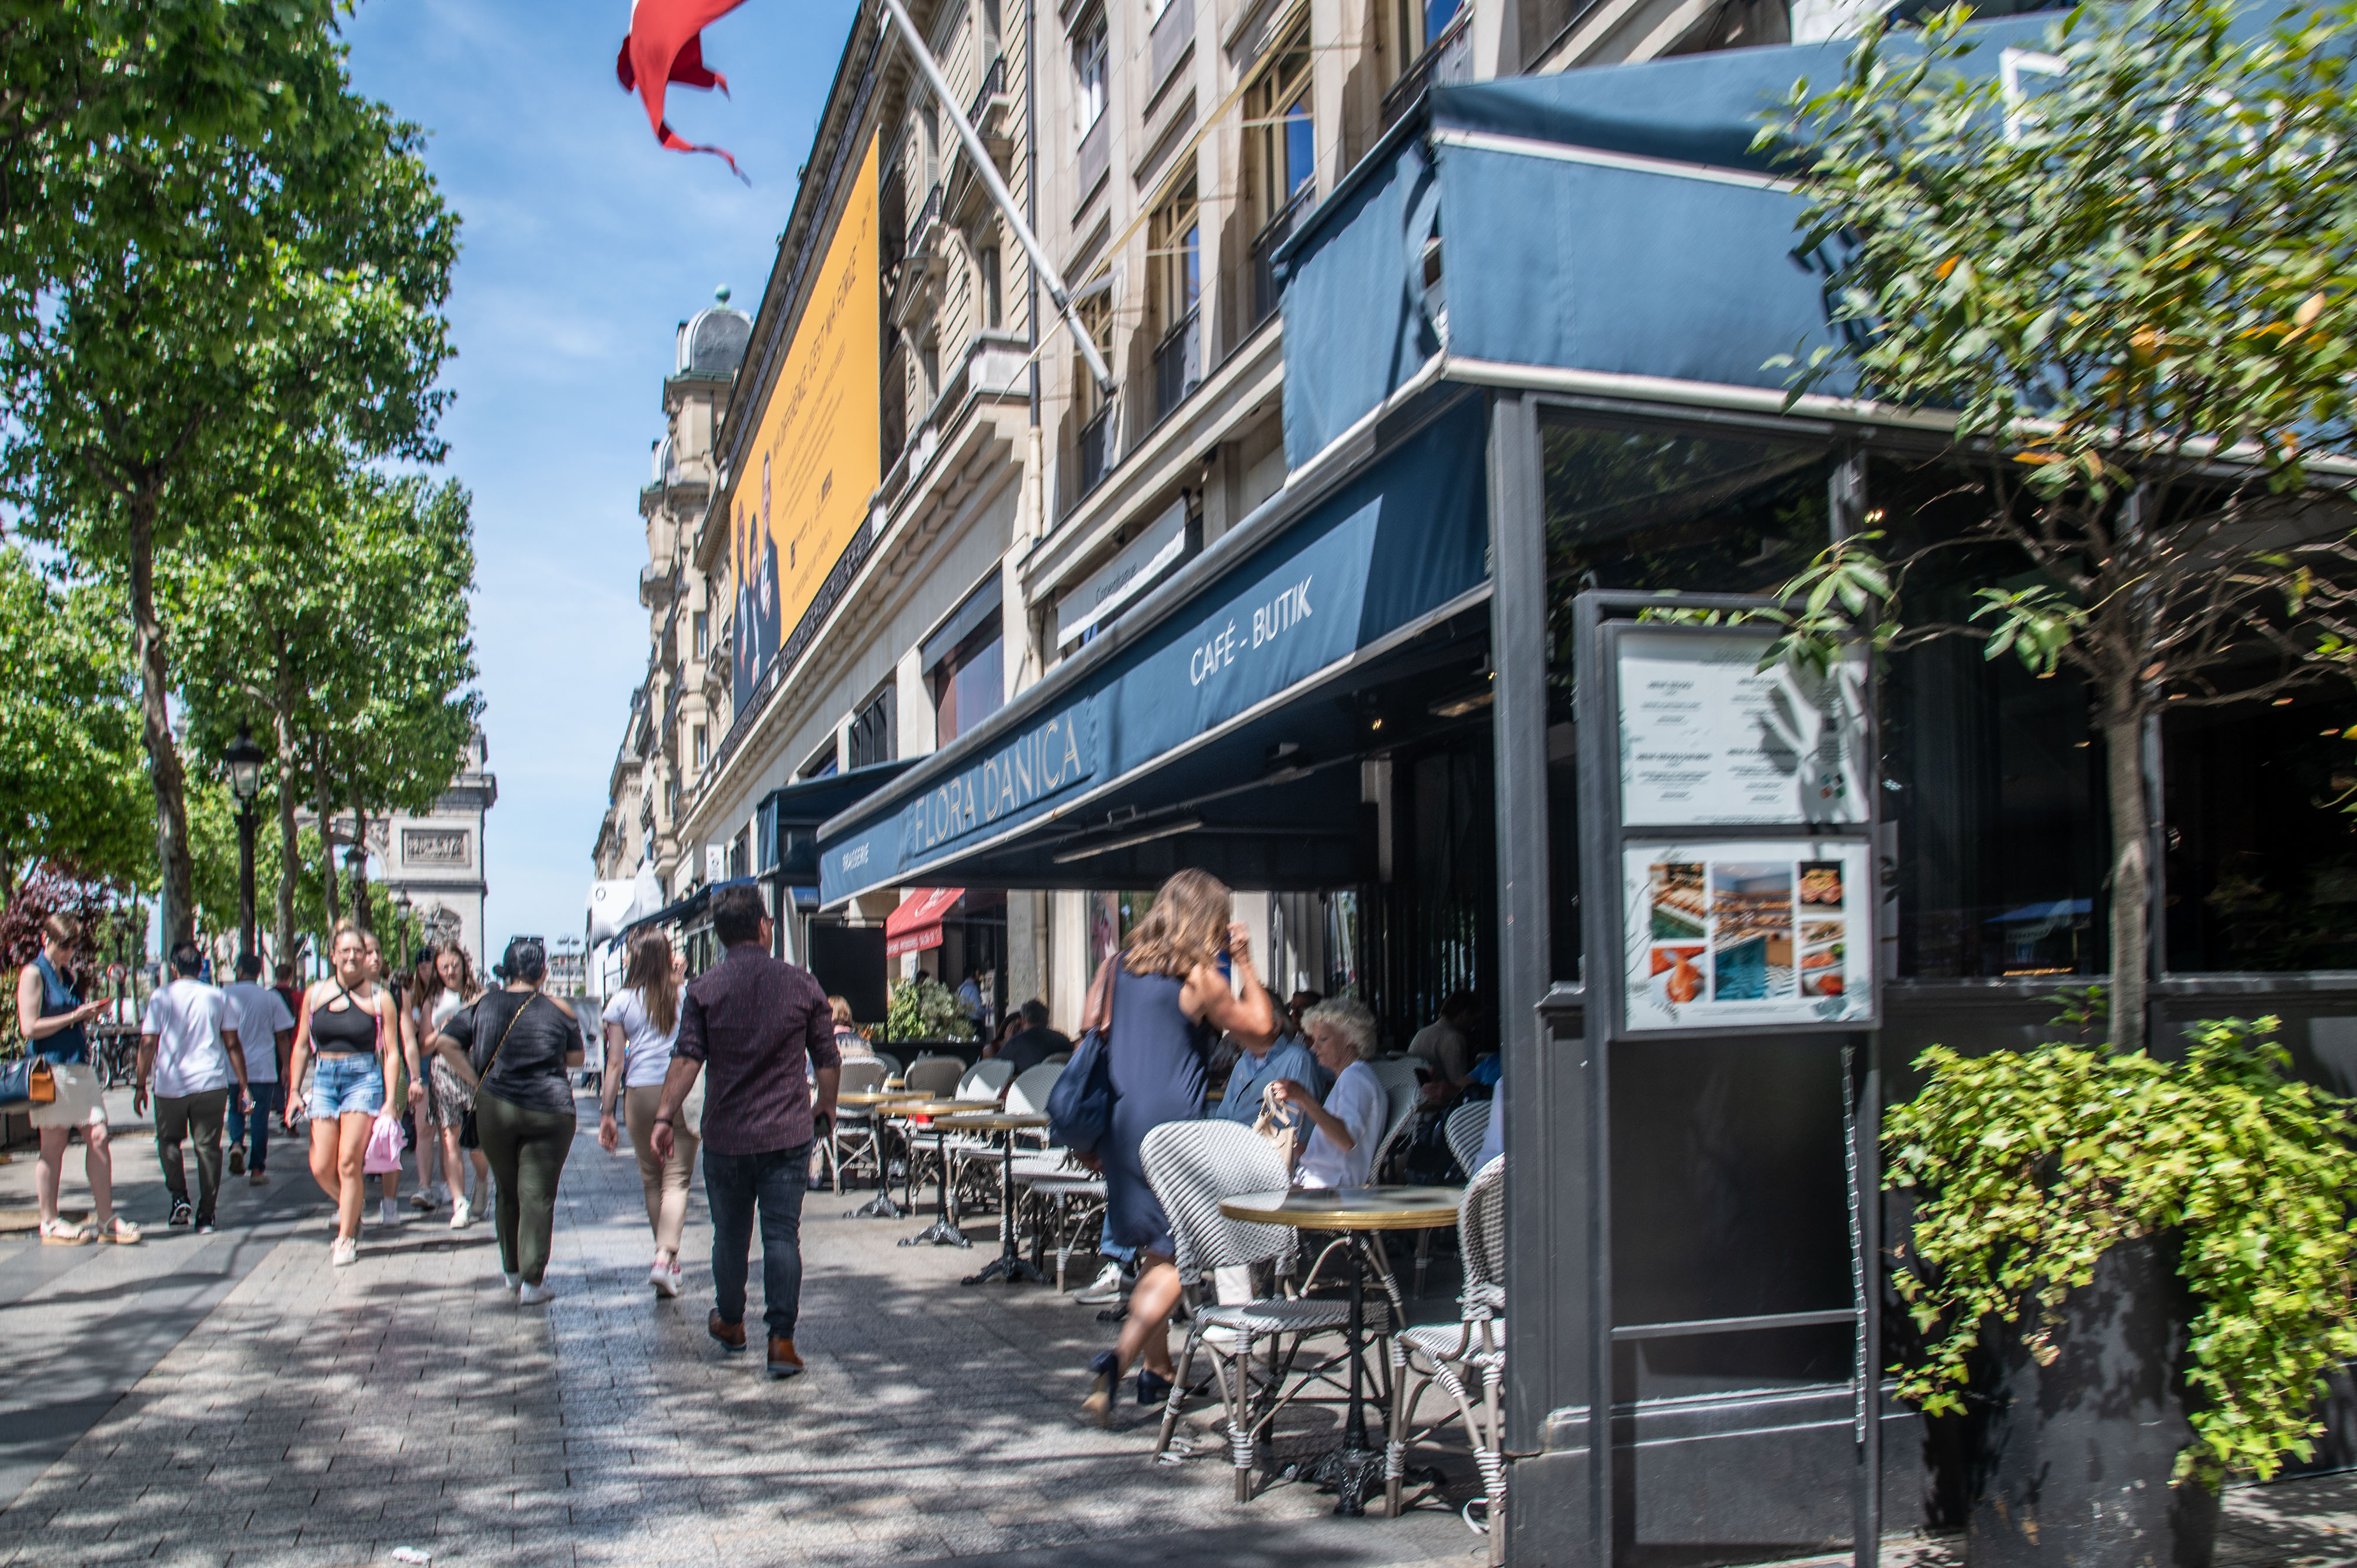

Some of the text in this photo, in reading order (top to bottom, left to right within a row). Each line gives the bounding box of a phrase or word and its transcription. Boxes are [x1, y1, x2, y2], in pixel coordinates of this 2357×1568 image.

[1190, 617, 1237, 687] CAFÉ
[1252, 573, 1314, 650] BUTIK
[915, 709, 1081, 852] FLORA DANICA
[842, 842, 870, 874] BRASSERIE
